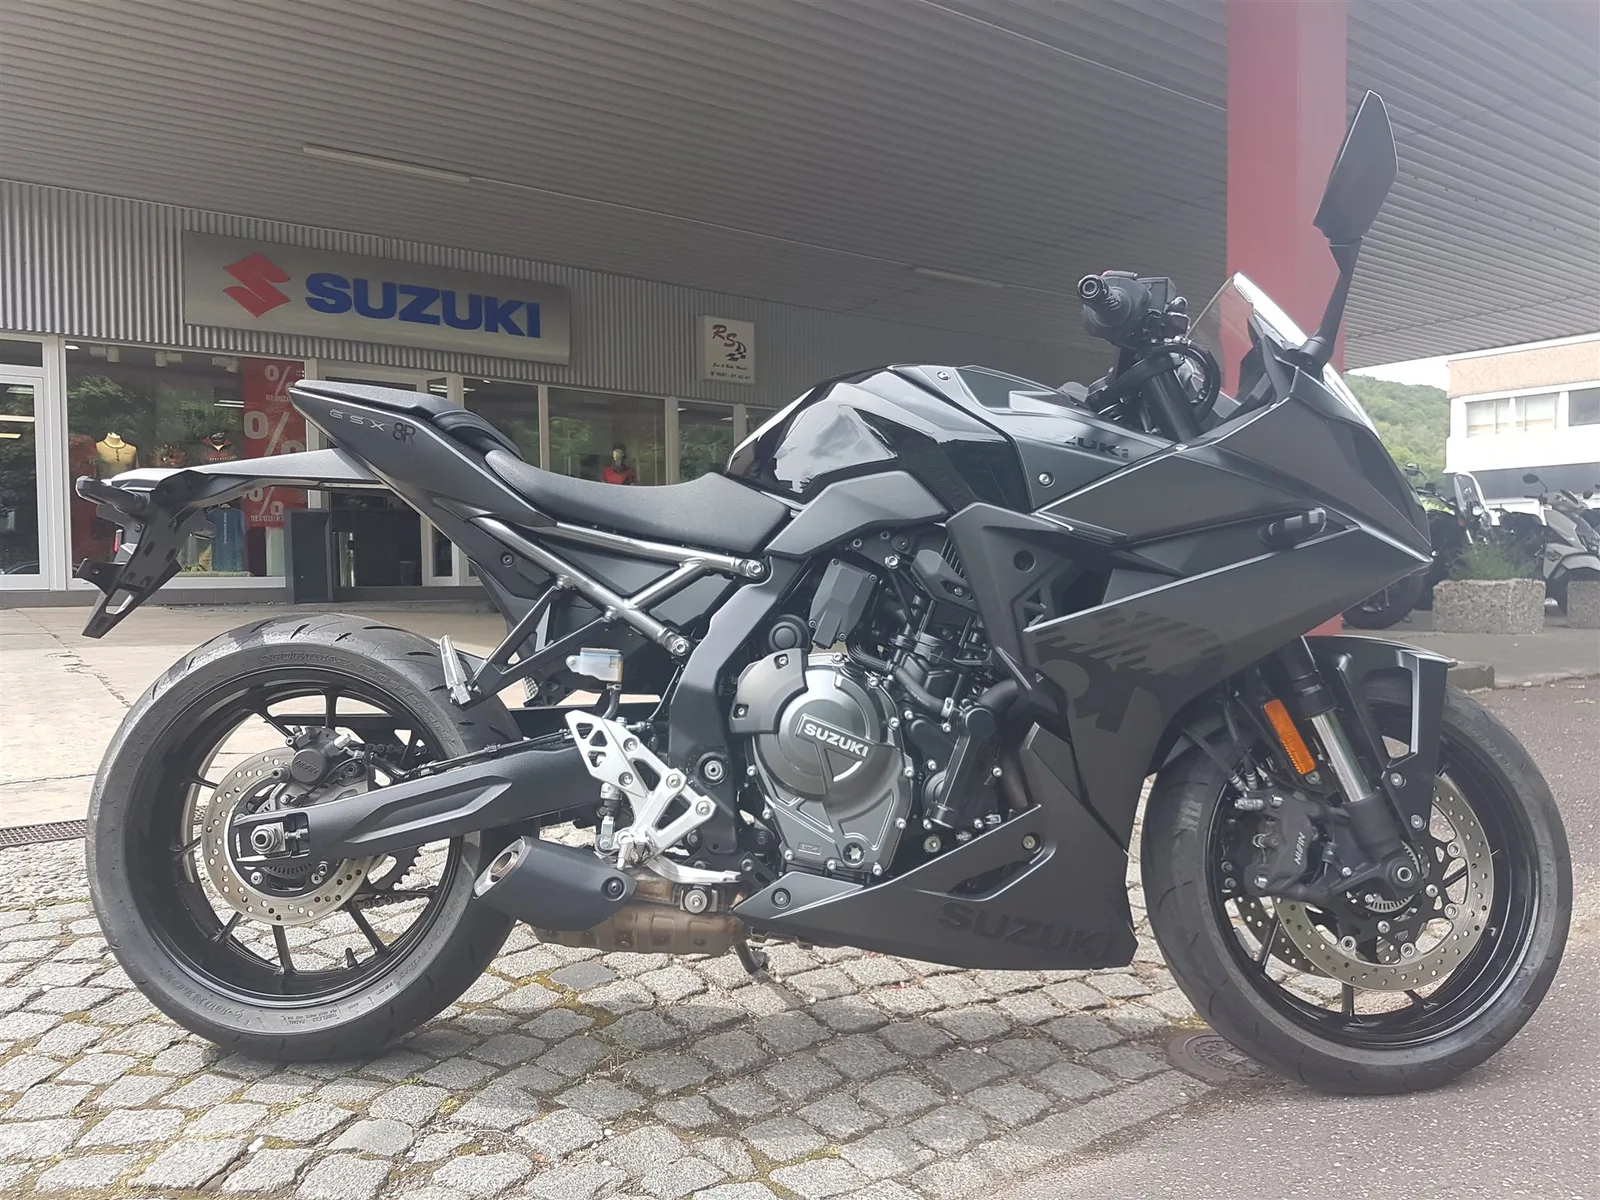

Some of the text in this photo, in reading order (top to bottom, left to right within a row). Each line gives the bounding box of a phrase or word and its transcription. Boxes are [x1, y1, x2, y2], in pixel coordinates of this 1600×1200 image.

[304, 272, 541, 339] SUZUKI
[392, 421, 416, 445] 8R
[803, 722, 869, 758] SUZUKI
[937, 901, 1118, 960] SUZUKI
